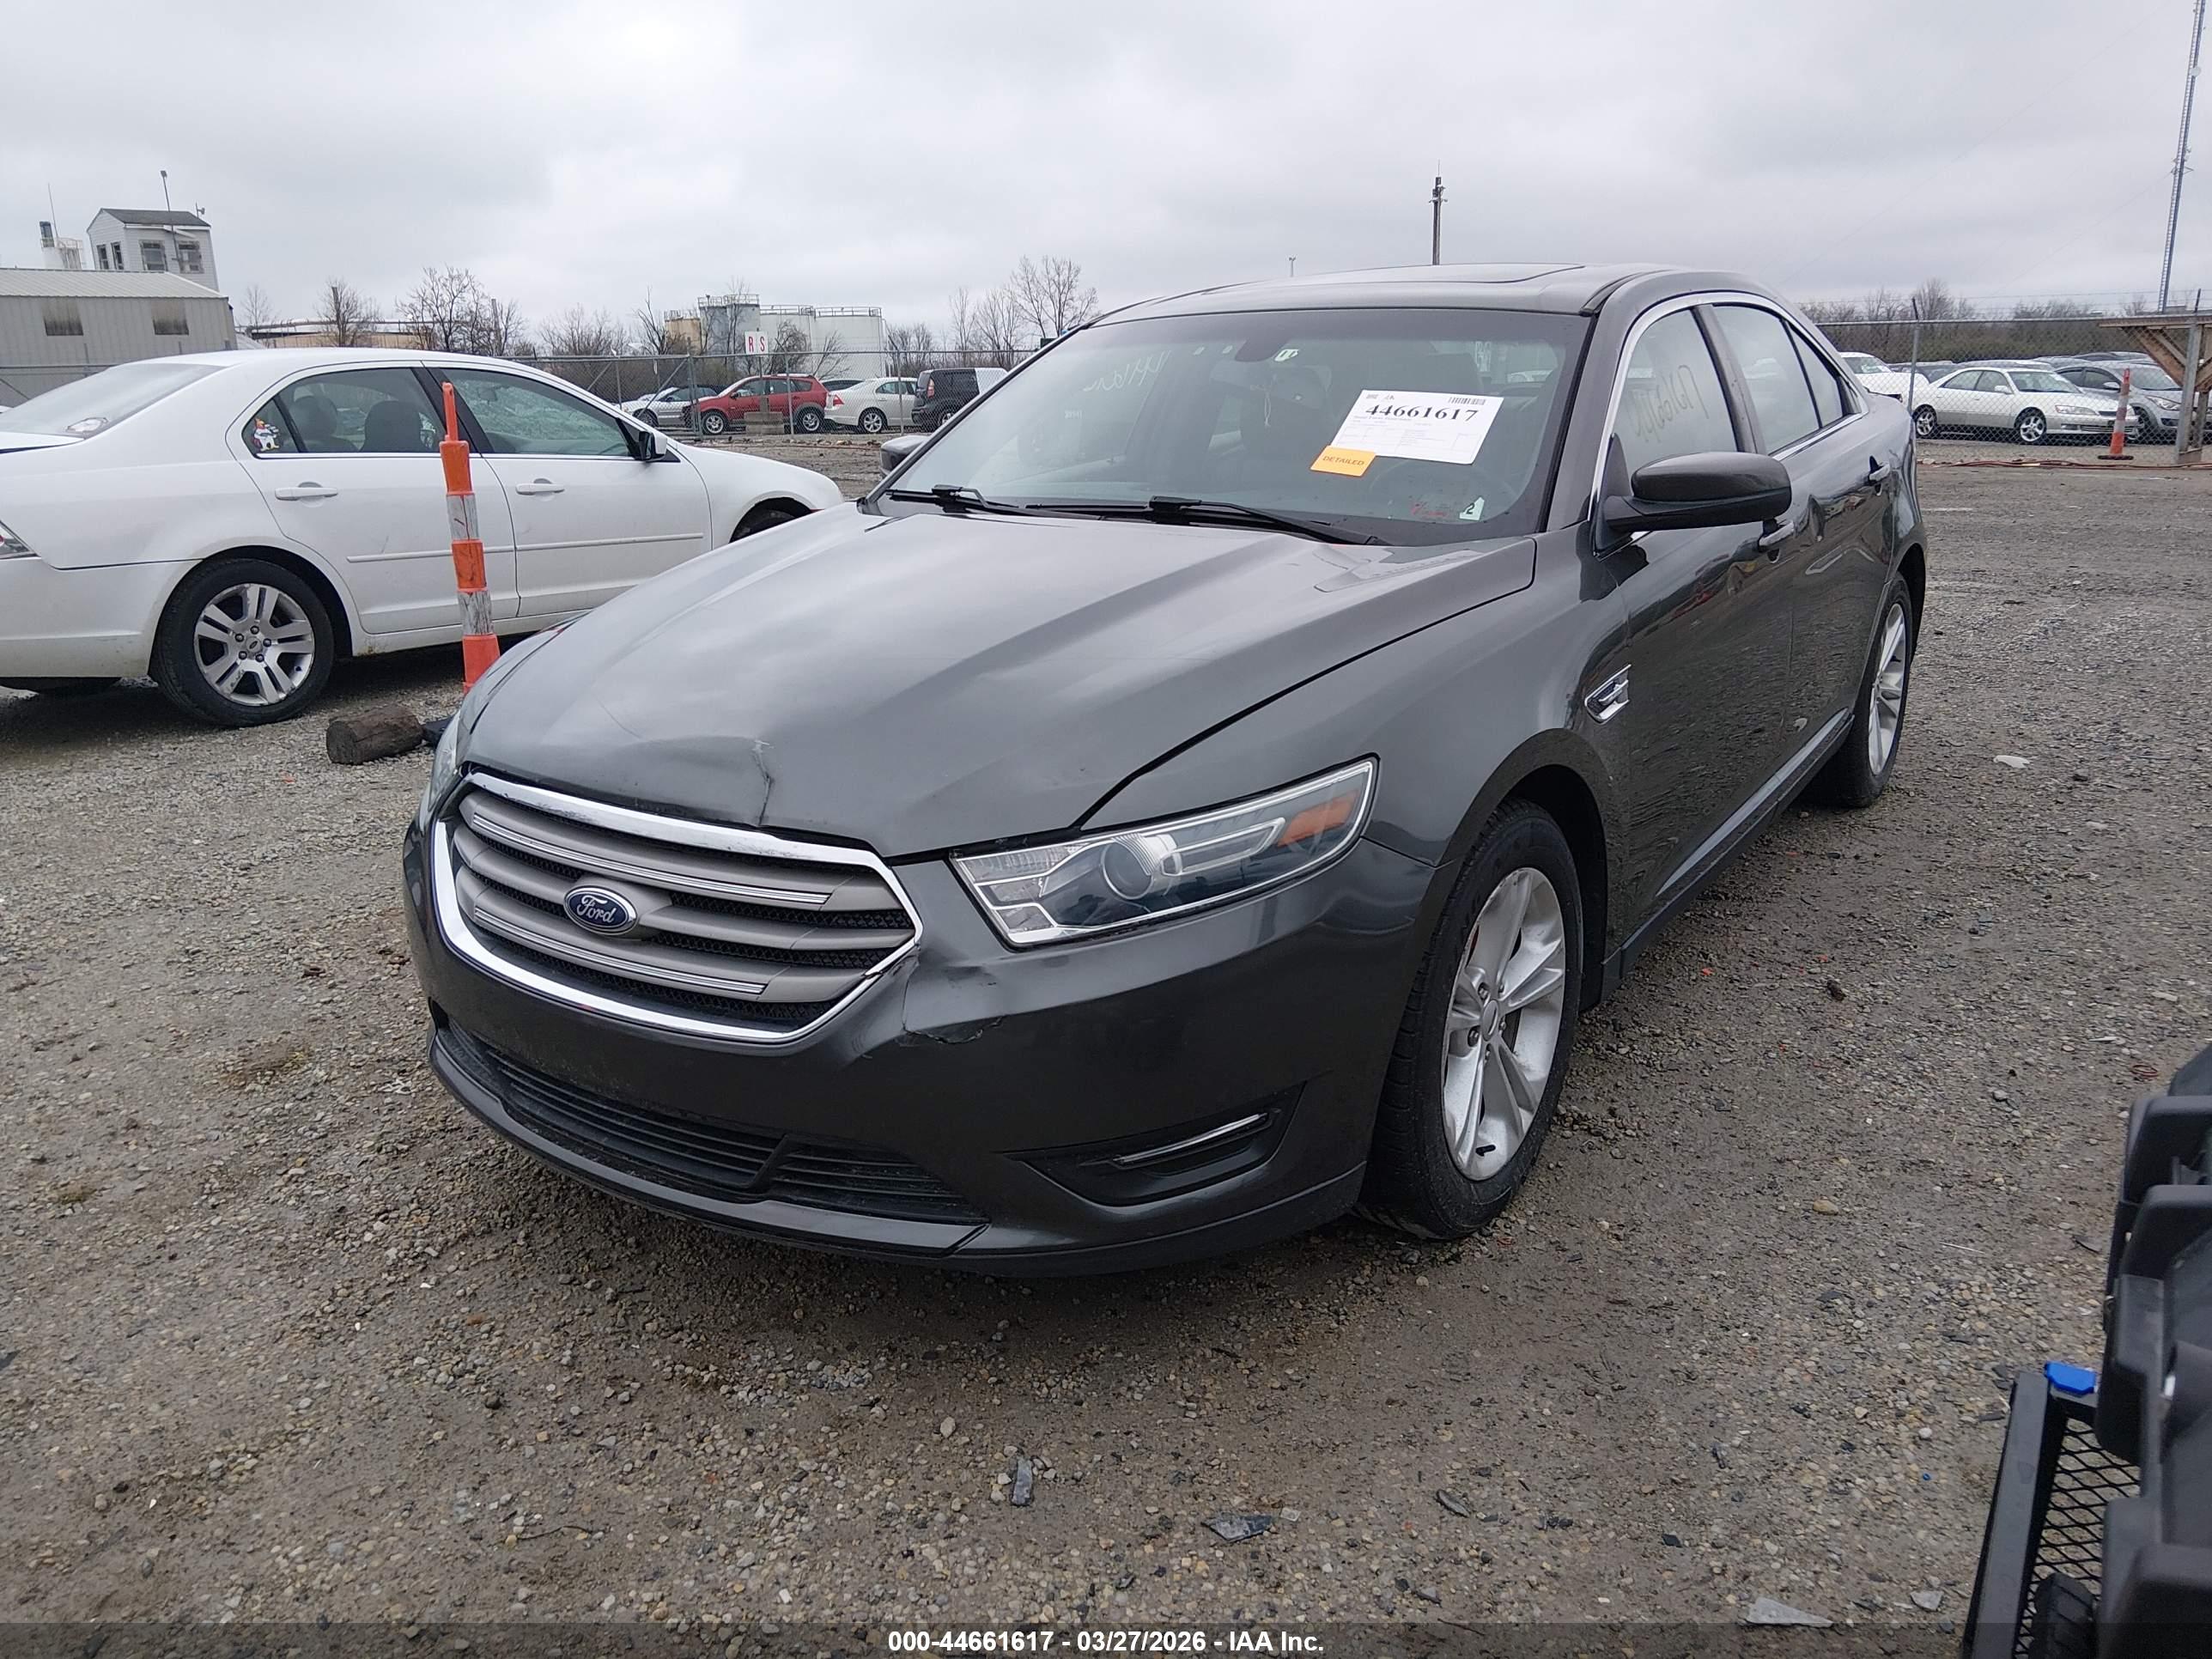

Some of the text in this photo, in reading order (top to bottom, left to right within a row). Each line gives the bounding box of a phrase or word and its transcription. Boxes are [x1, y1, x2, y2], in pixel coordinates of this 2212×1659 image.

[748, 336, 765, 352] R S
[1365, 404, 1479, 422] 44661617
[1322, 455, 1365, 465] DETAILED
[576, 895, 617, 923] Ford
